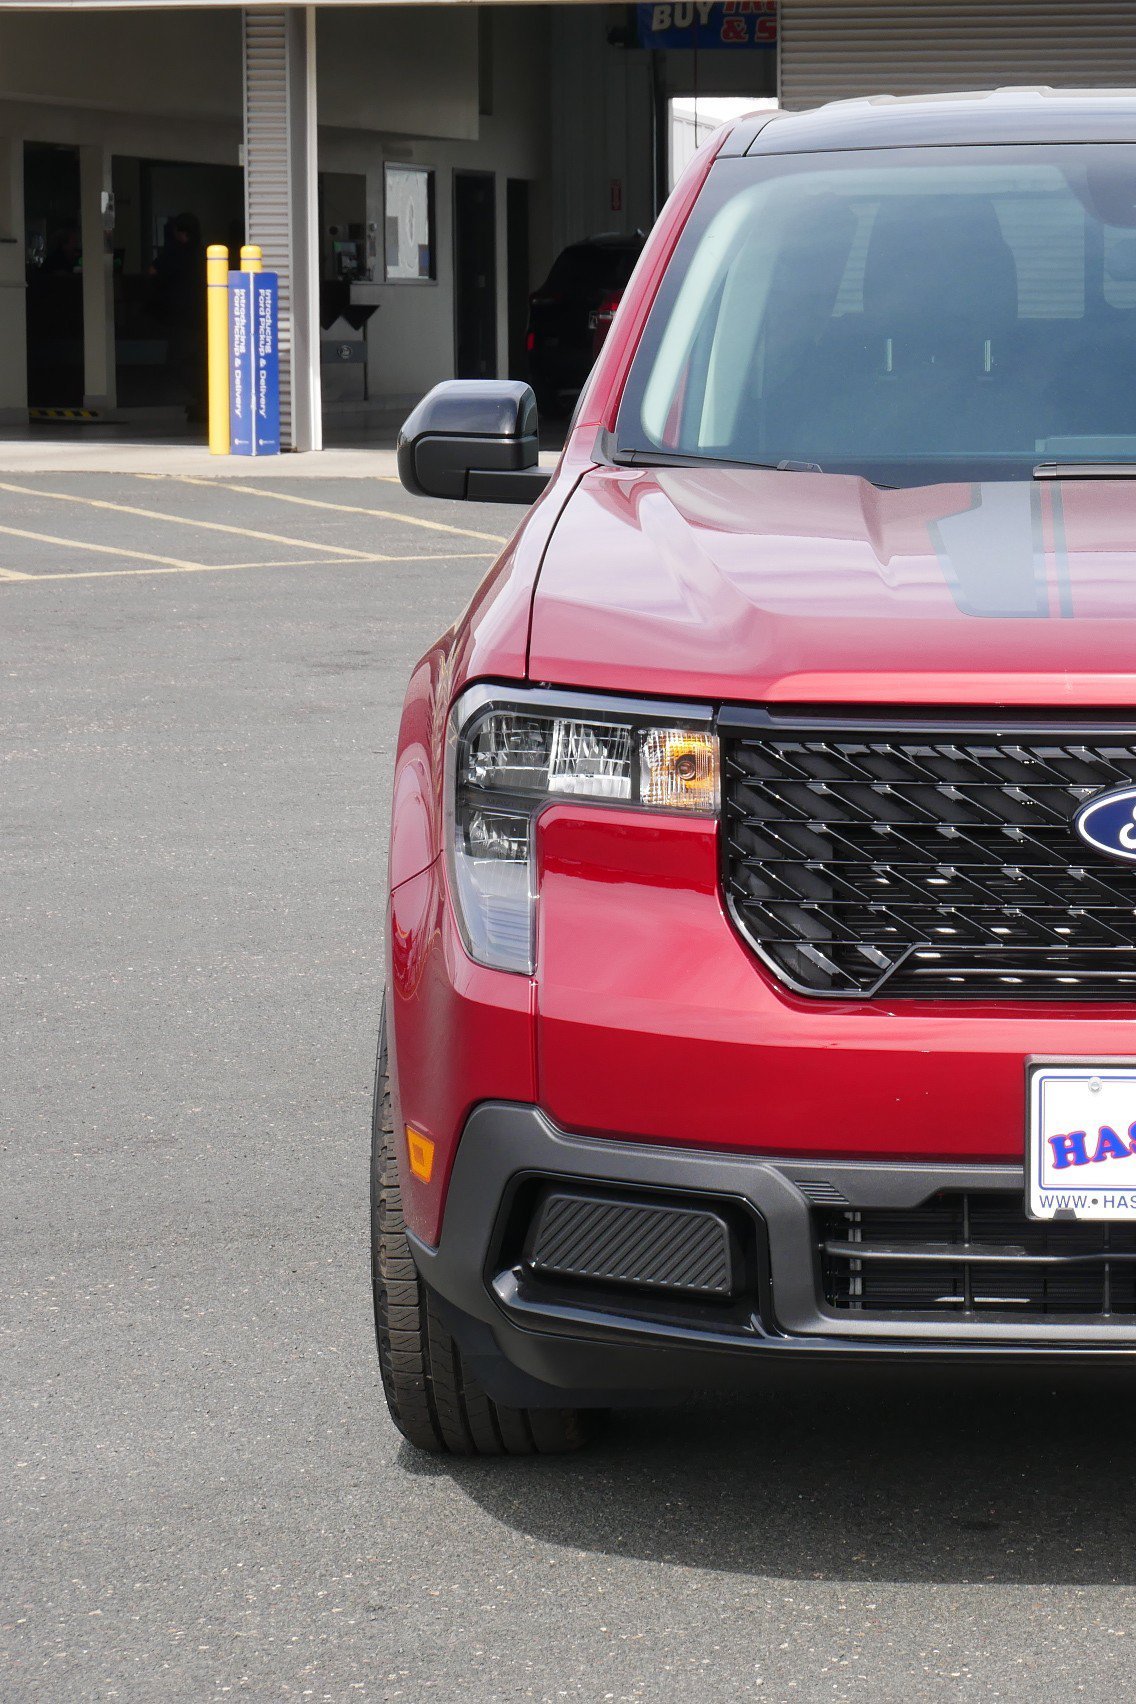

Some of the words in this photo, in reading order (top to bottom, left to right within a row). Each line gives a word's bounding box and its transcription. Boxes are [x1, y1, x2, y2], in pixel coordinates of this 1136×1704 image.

[651, 2, 713, 31] BUY
[720, 16, 748, 42] &
[233, 288, 241, 314] Ford
[235, 357, 241, 368] &
[260, 357, 267, 368] &
[234, 369, 242, 419] Delivery
[259, 369, 267, 419] Delivery
